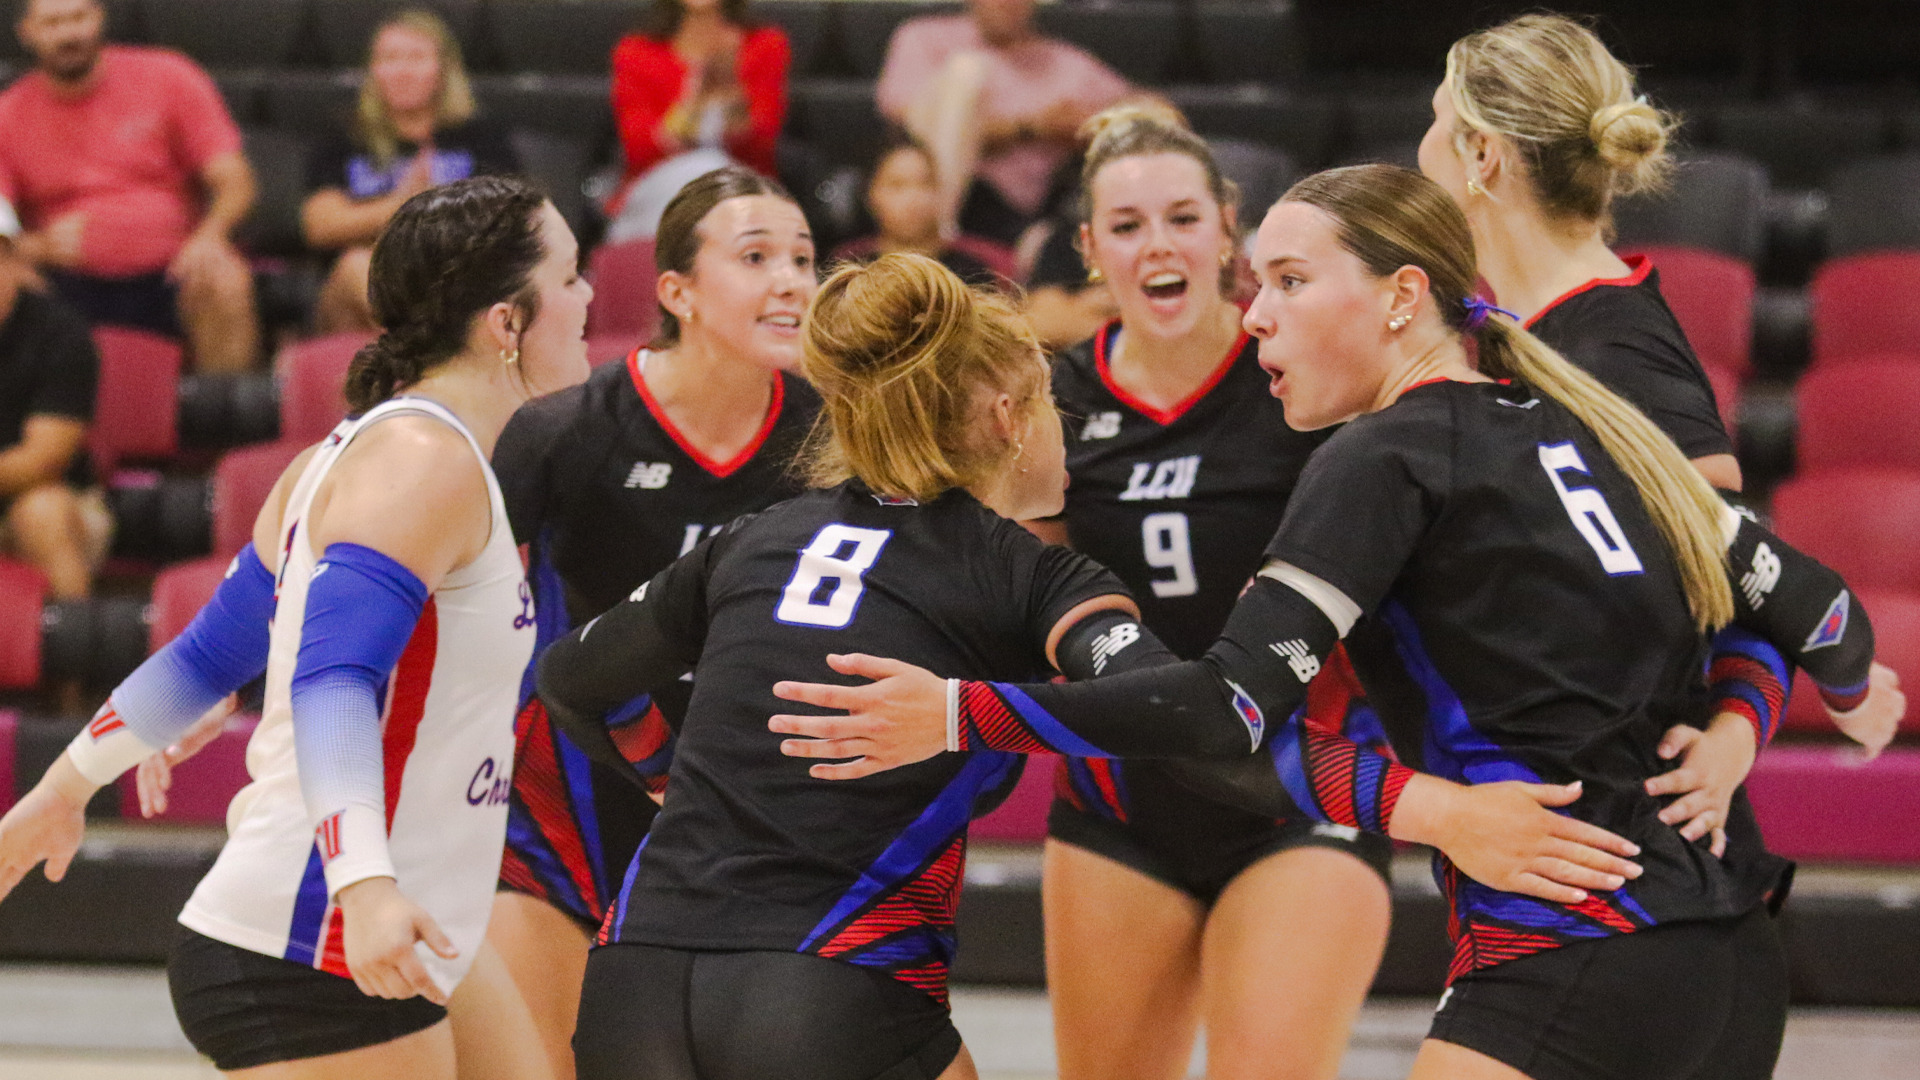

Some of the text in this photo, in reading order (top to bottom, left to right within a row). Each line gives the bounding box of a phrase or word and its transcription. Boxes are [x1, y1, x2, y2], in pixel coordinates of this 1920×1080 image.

[623, 461, 673, 489] NB
[1118, 454, 1202, 501] LCU
[1538, 440, 1644, 576] 6
[773, 522, 893, 630] 8
[1141, 512, 1198, 598] 9
[1740, 541, 1781, 611] NB
[1091, 622, 1141, 676] NB
[1268, 638, 1320, 684] NB
